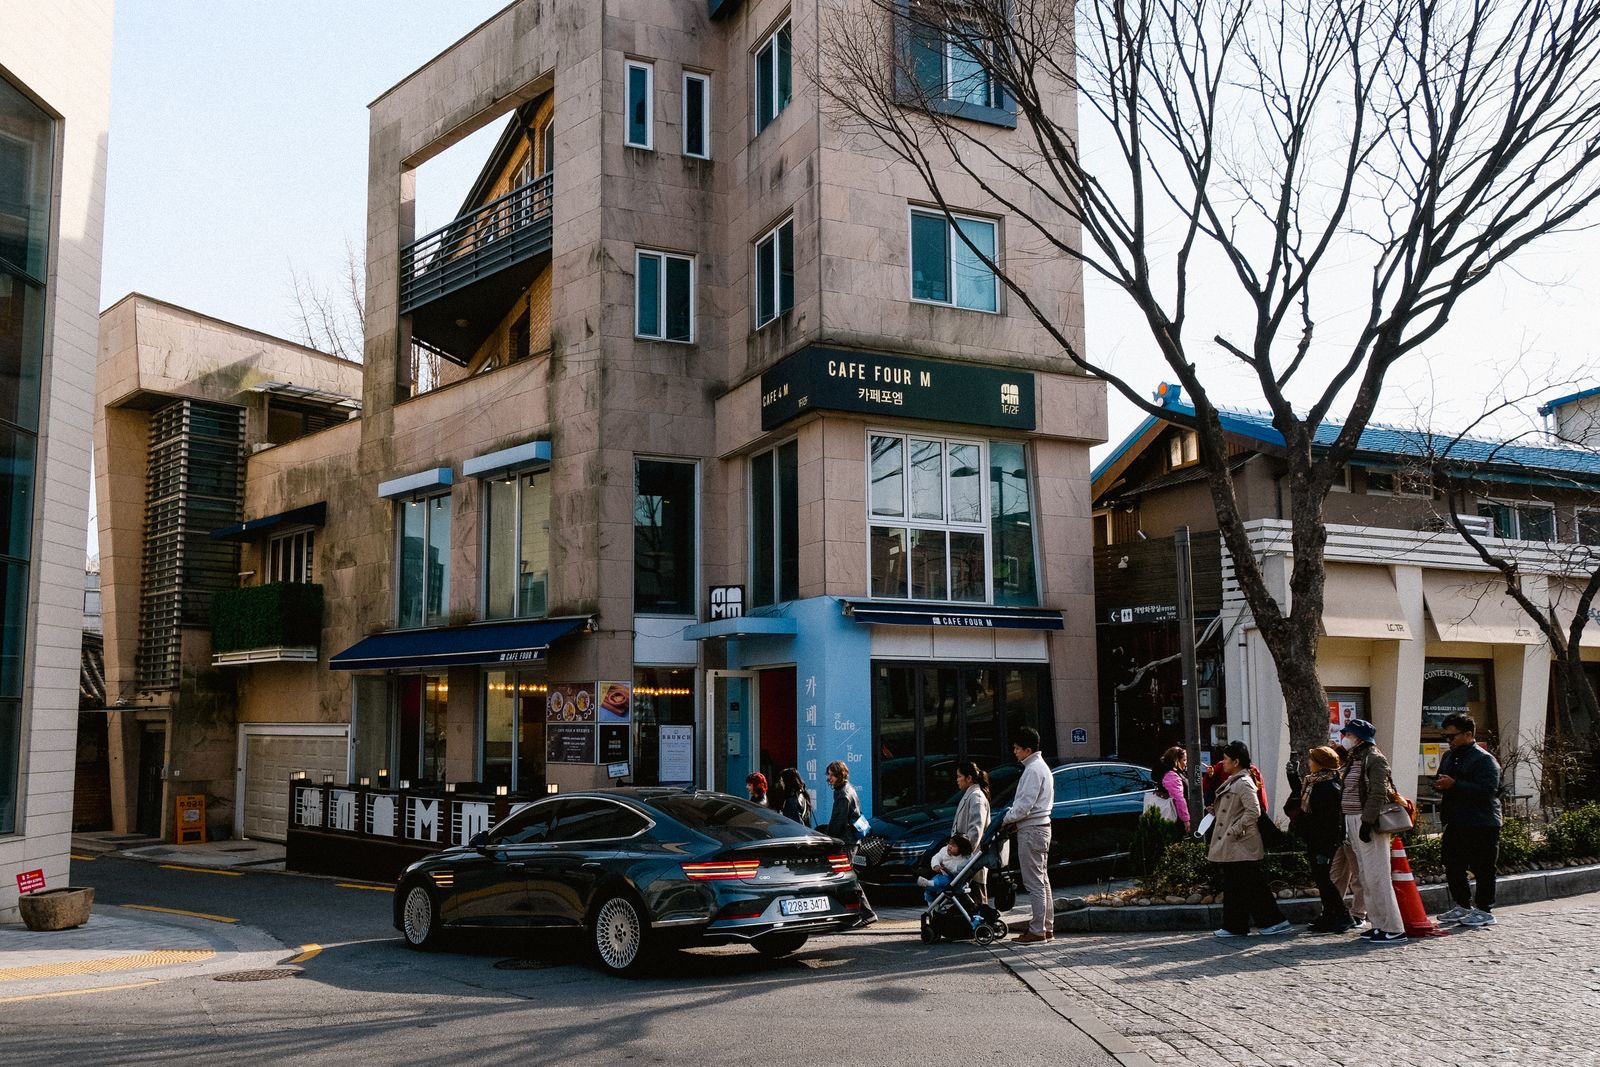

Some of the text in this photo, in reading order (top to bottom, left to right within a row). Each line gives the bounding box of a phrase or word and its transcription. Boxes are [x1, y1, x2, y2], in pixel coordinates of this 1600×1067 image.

[828, 360, 931, 388] CAFE FOUR M
[763, 390, 777, 407] CAFE
[783, 383, 788, 396] M
[858, 388, 903, 405] 카페포엠
[1001, 404, 1020, 414] 1F/2F
[942, 617, 961, 626] CAFE
[964, 618, 984, 627] FOUR
[986, 619, 993, 627] M
[506, 652, 518, 661] CAFE
[520, 651, 531, 660] FOUR
[533, 651, 539, 659] M
[1454, 671, 1474, 688] STORY
[834, 719, 856, 731] Cafe
[847, 752, 863, 763] Bar
[809, 898, 829, 911] 3471
